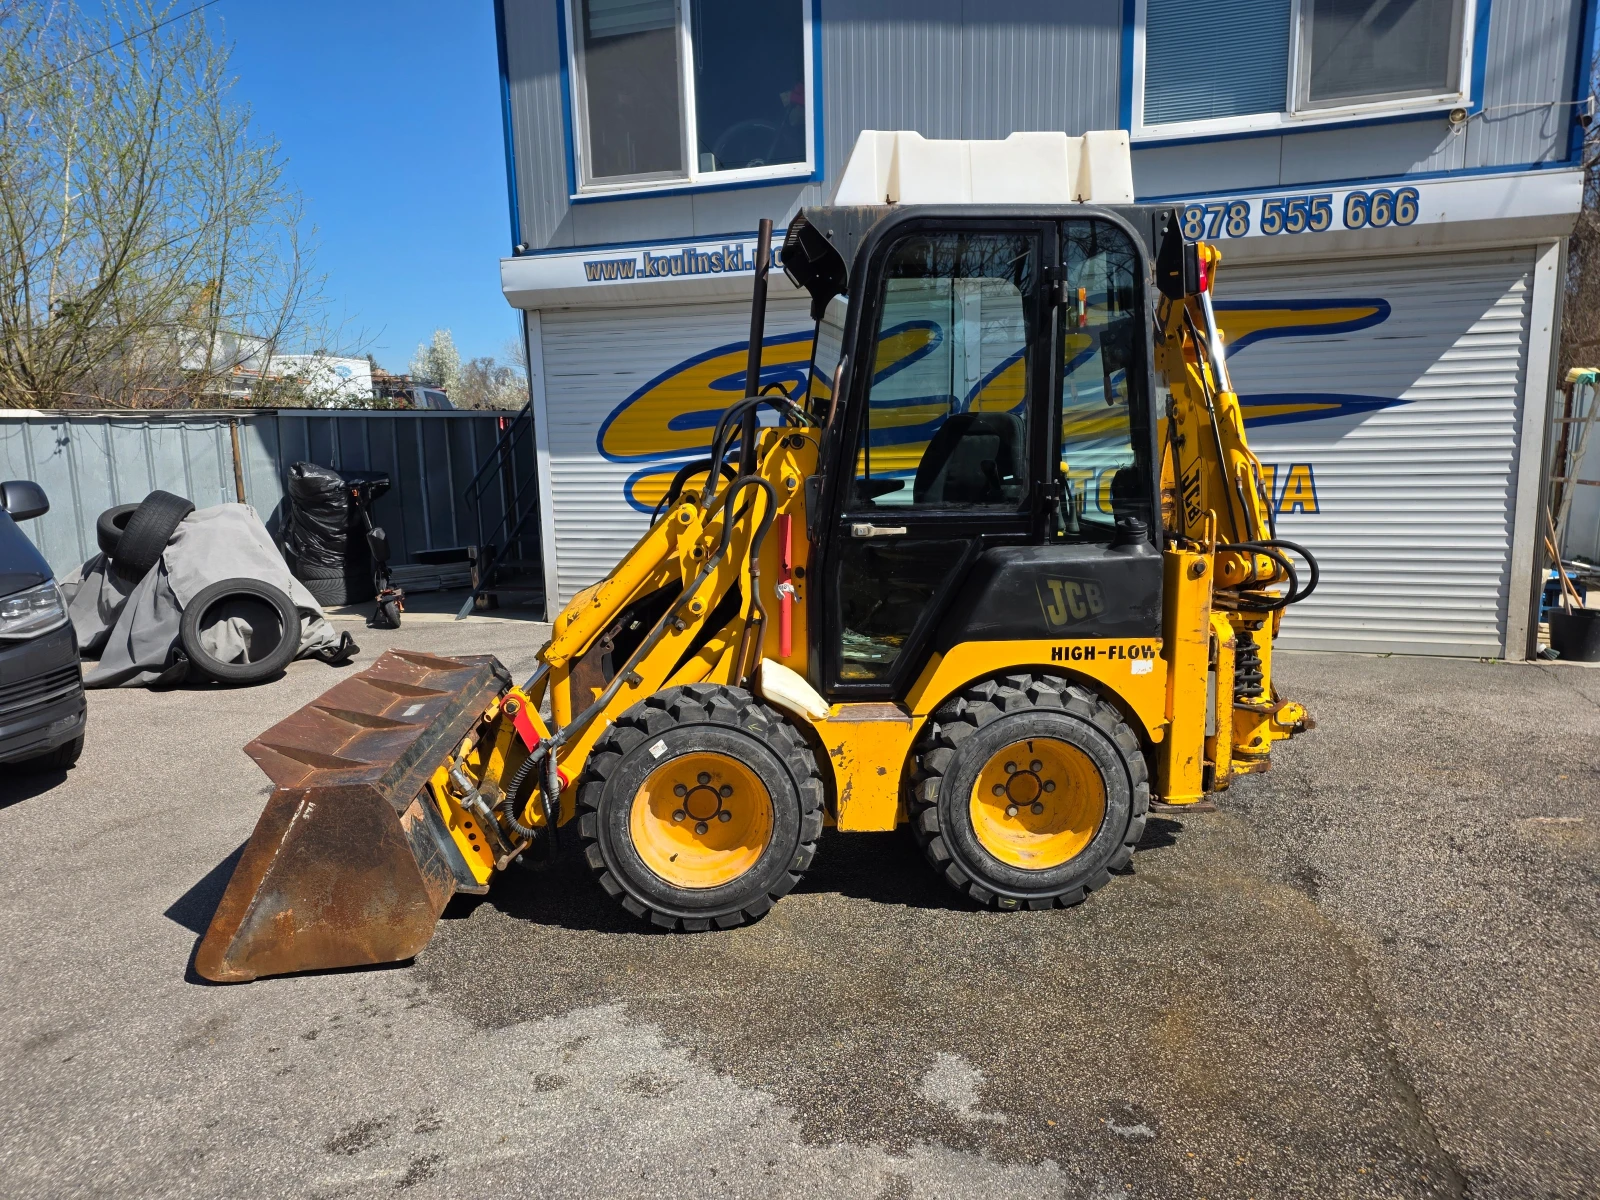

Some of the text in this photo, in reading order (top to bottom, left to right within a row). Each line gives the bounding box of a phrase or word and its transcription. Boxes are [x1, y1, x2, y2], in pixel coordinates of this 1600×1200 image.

[1183, 187, 1419, 241] 878 555 666
[1181, 467, 1200, 522] JCB
[1047, 579, 1104, 626] JCB
[1051, 645, 1155, 661] HIGH-FLOW
